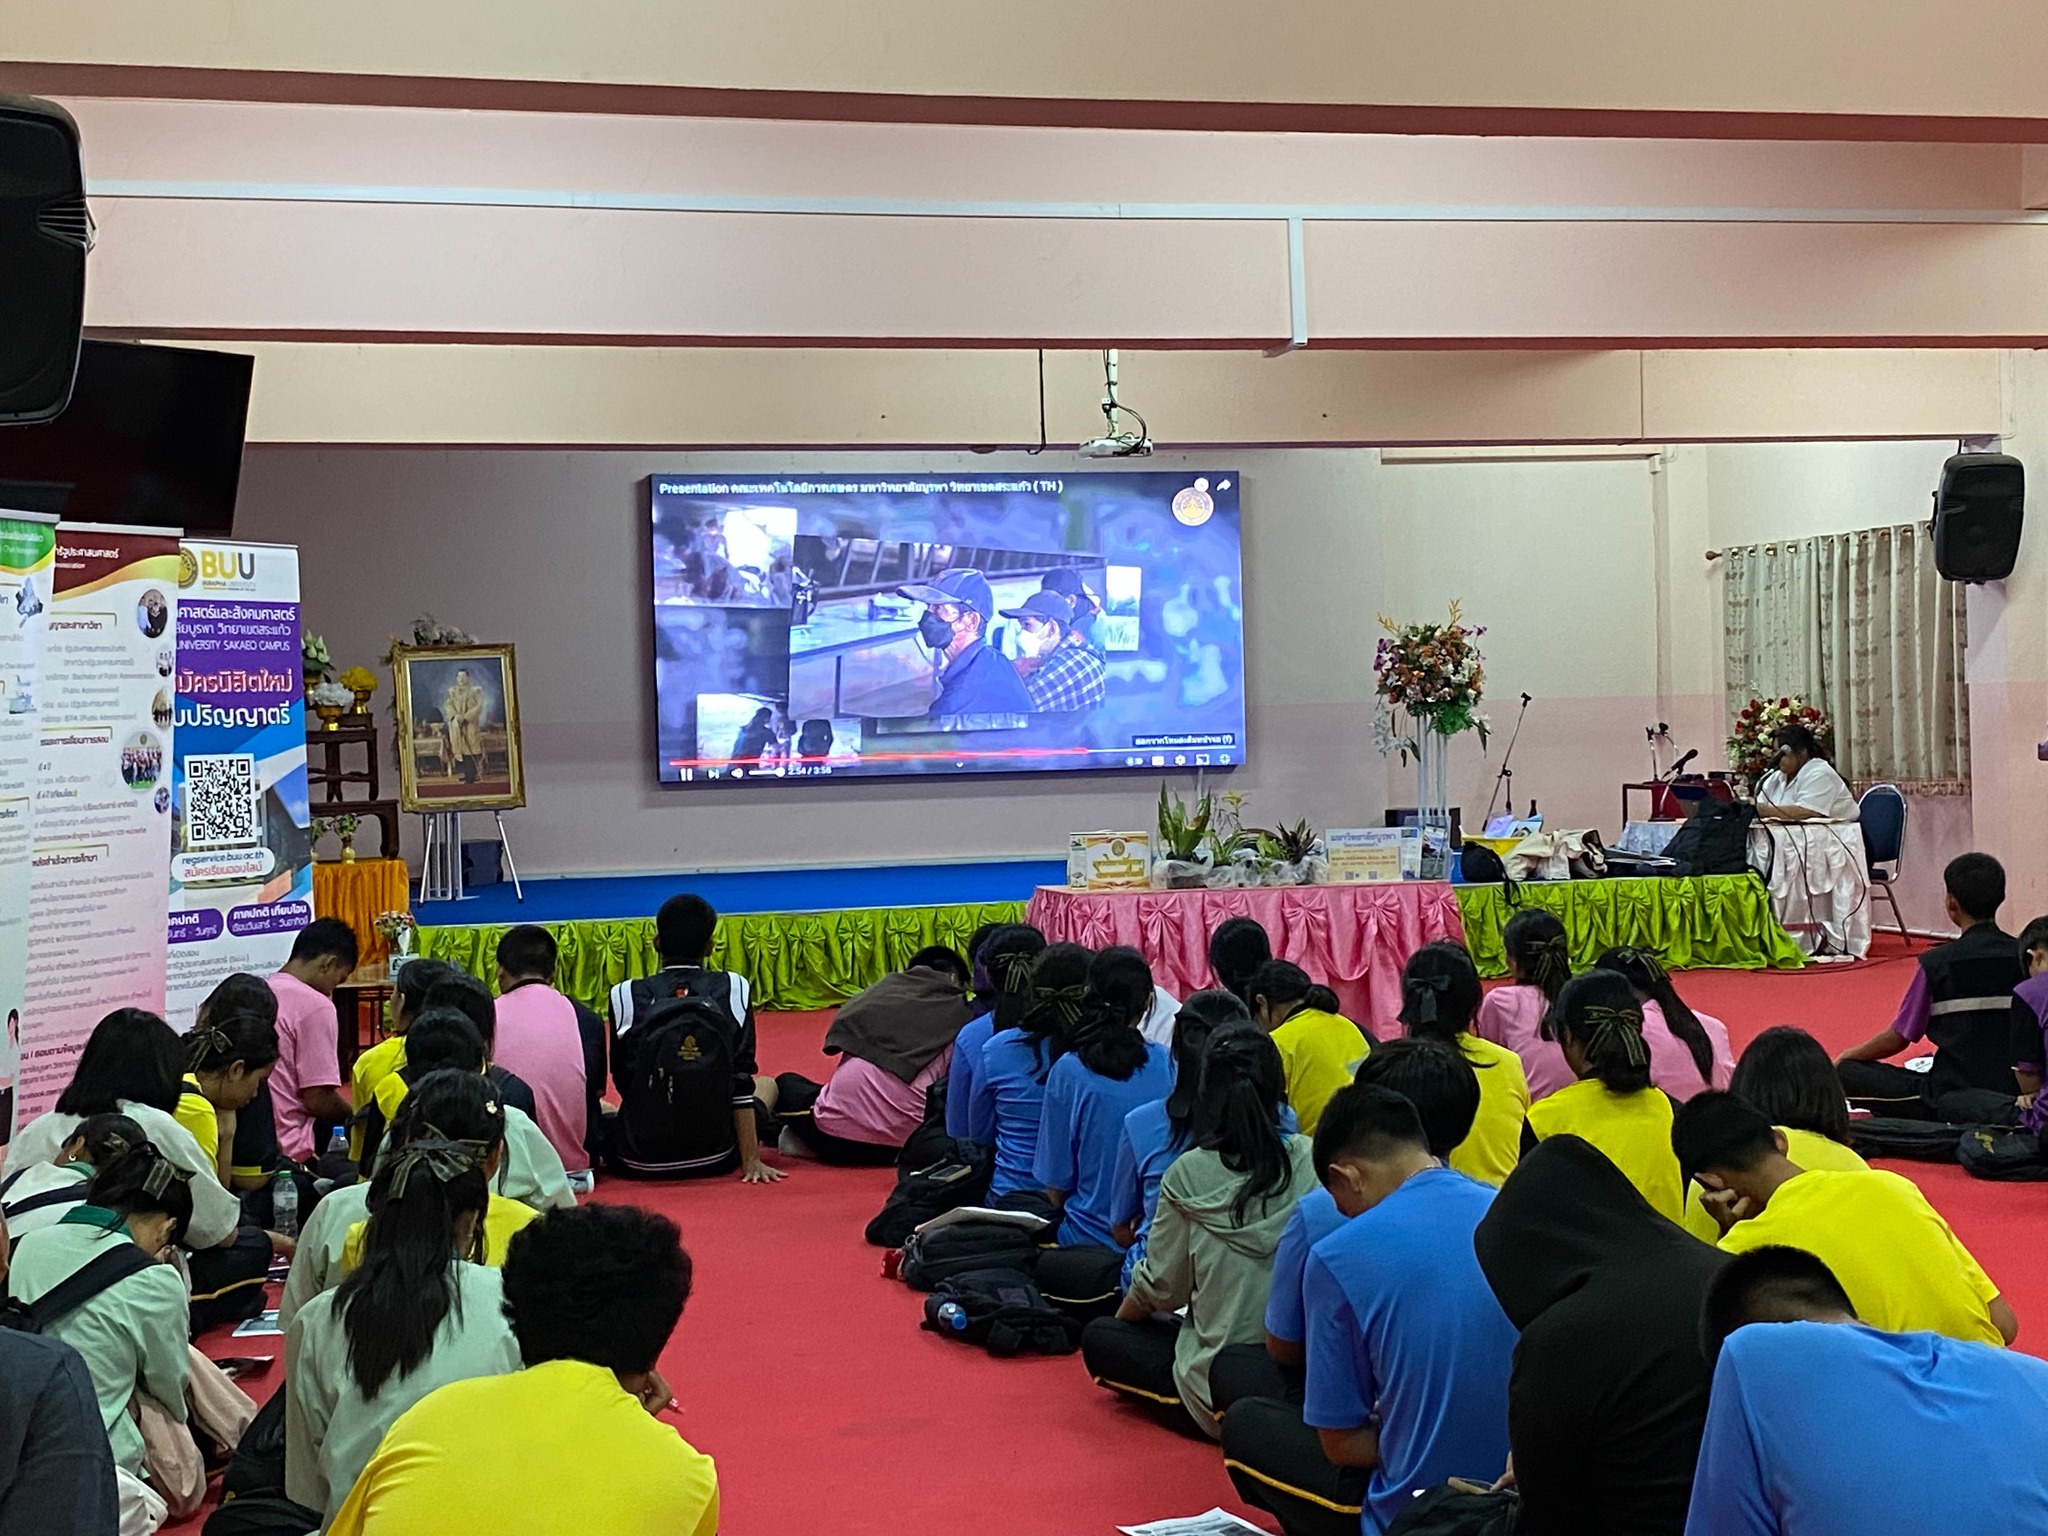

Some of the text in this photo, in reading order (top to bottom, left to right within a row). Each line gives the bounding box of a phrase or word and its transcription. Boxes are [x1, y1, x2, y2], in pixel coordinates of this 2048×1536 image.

[659, 483, 729, 495] Presentation
[201, 551, 255, 580] BUU
[223, 640, 257, 651] SAKAEO
[259, 641, 290, 651] CAMPUS
[175, 668, 293, 693] มัครนิสิตใหม่
[182, 851, 265, 867] regservice.buu.ac.th
